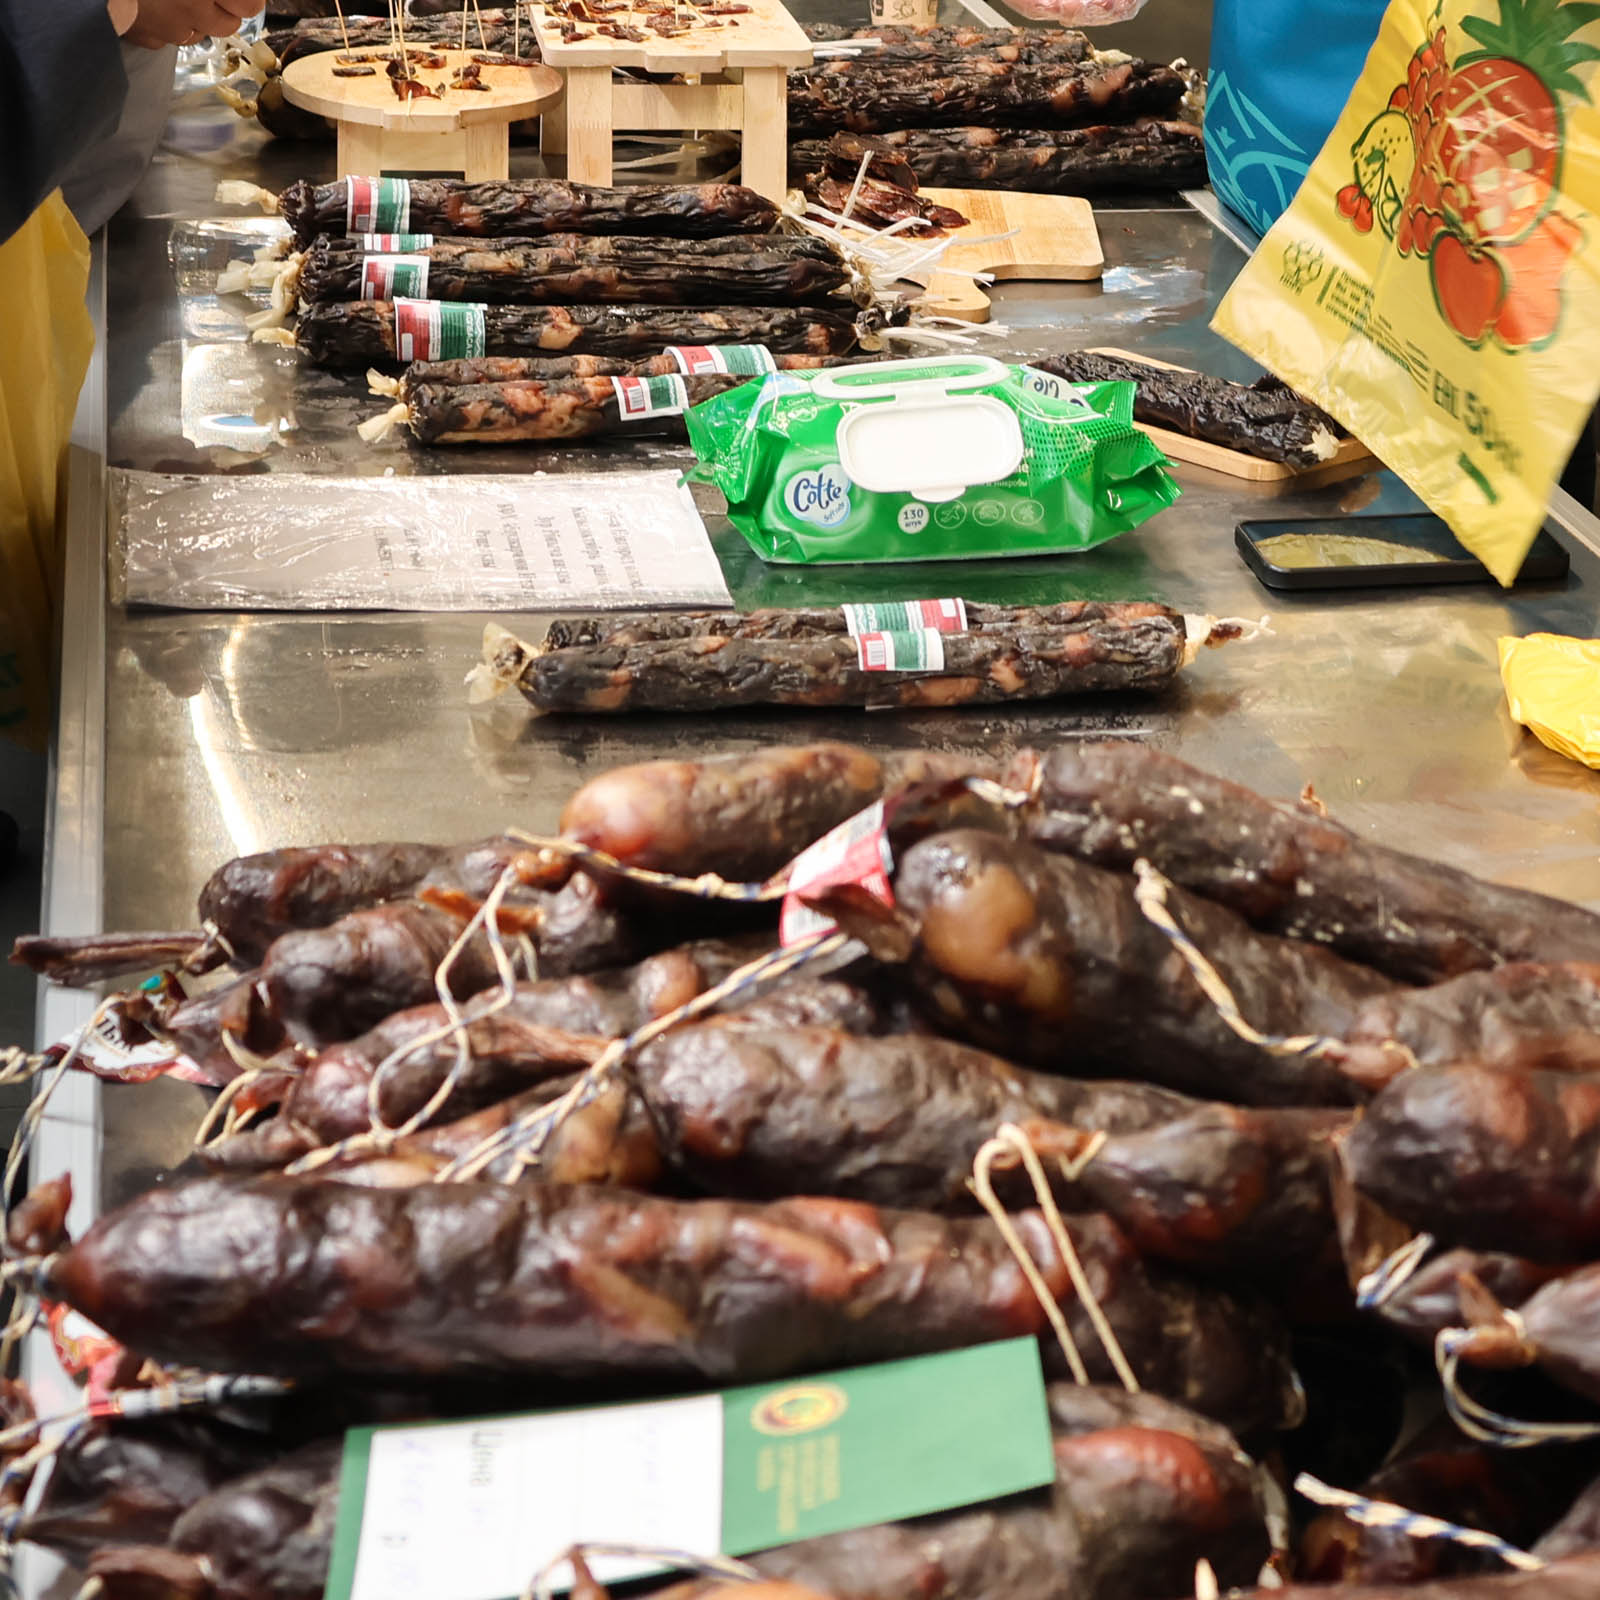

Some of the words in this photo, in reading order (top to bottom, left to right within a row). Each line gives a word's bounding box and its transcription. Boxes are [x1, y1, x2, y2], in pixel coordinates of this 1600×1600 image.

[793, 472, 842, 512] Cotte
[902, 507, 924, 521] 130
[904, 519, 923, 529] штук
